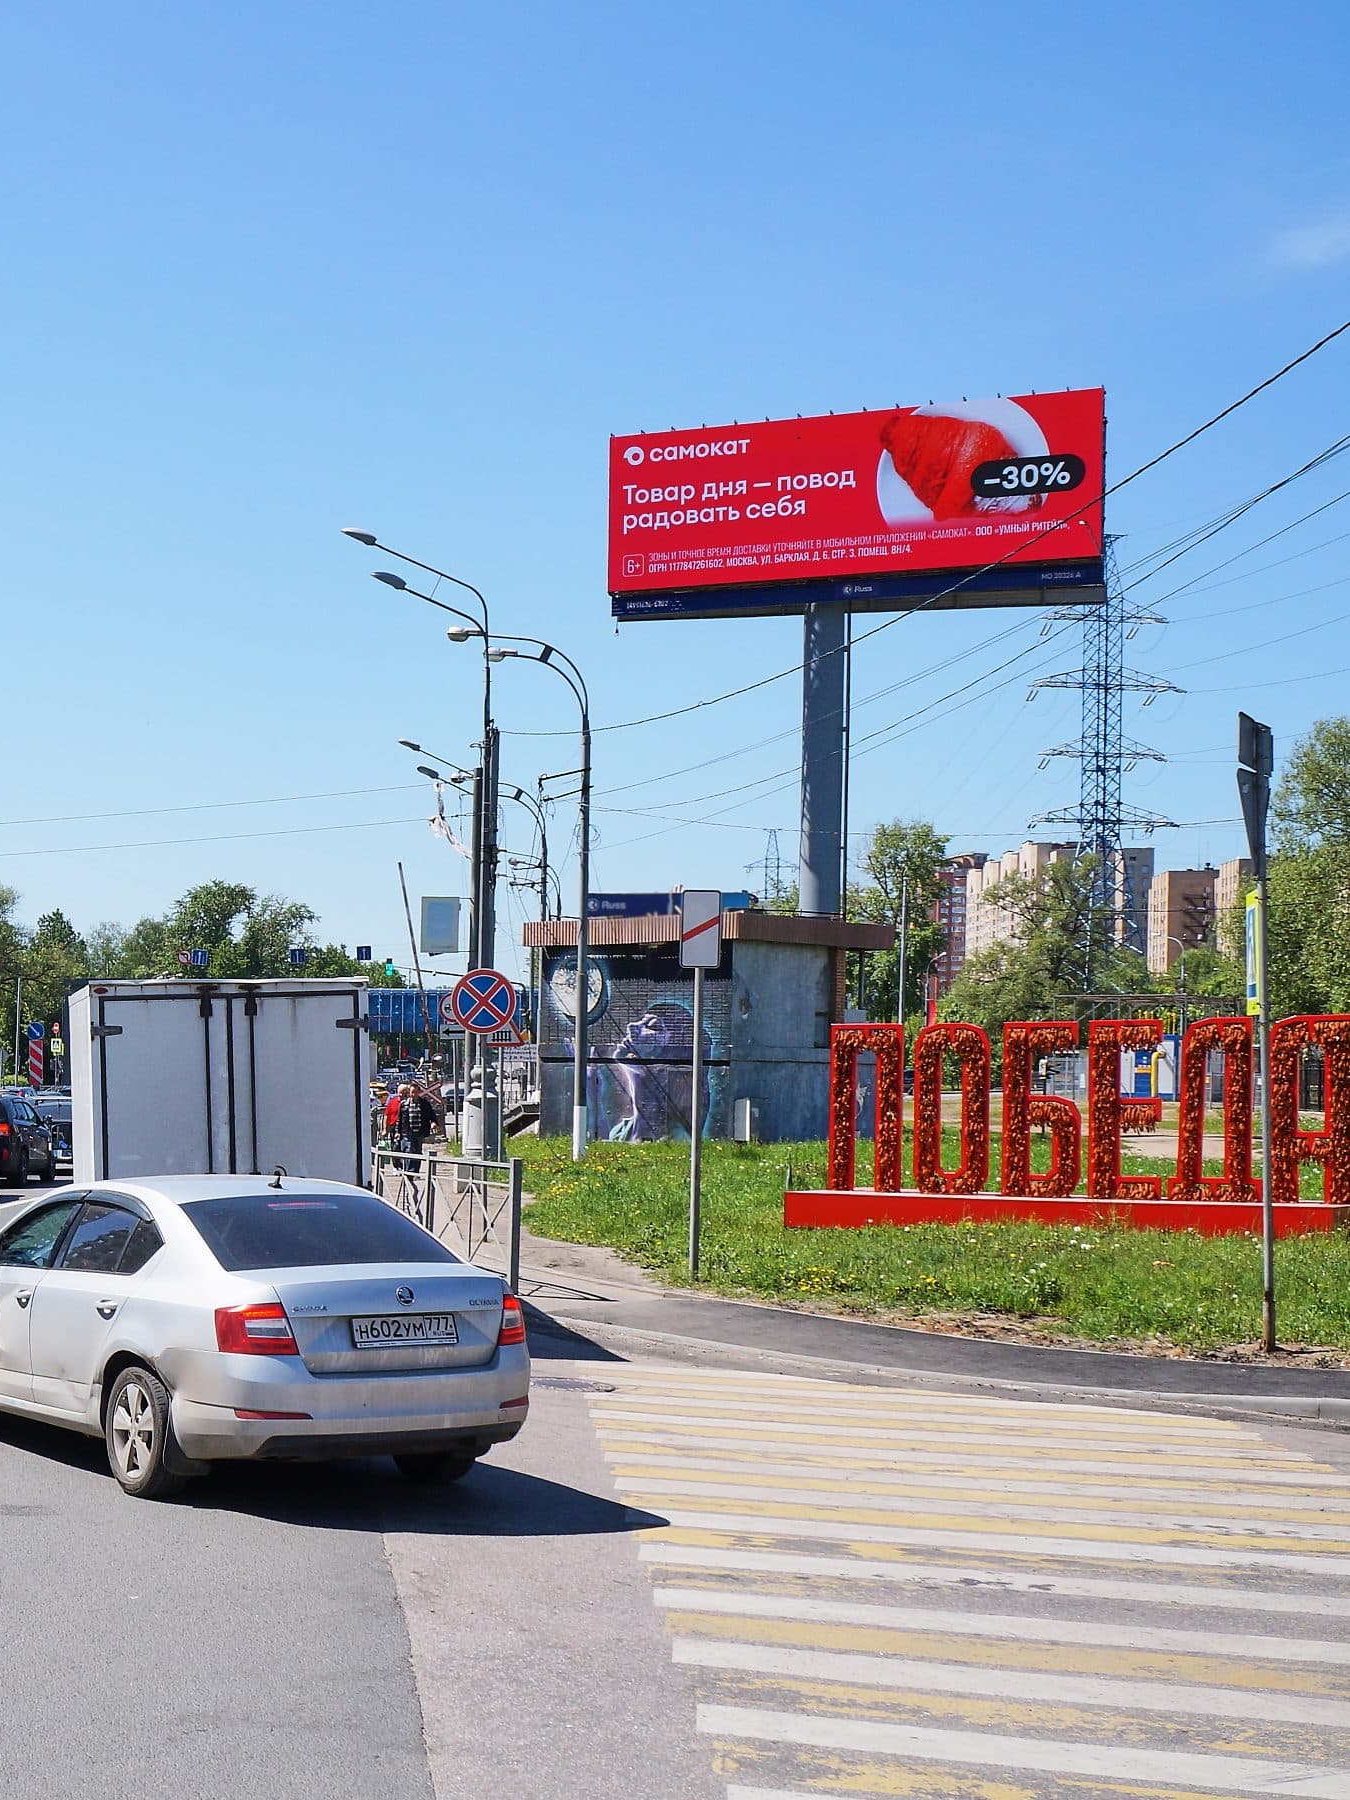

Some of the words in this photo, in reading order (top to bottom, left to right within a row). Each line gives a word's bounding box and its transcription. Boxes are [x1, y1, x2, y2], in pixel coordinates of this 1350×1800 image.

[649, 438, 751, 462] самокат
[622, 483, 696, 505] Товар
[701, 479, 747, 501] дня
[777, 469, 857, 492] повод
[983, 461, 1071, 490] -30%
[622, 506, 740, 535] радовать
[745, 494, 806, 519] себя
[648, 552, 670, 562] ЗОНЫ
[671, 552, 677, 560] И
[678, 548, 705, 560] ТОЧНОЕ
[707, 546, 731, 557] ВРЕМЯ
[733, 543, 771, 556] ДОСТАВКИ
[773, 539, 814, 553] УТОЧНЯЙТЕ
[816, 539, 822, 549] В
[823, 535, 872, 548] МОБИЛЬНОМ
[873, 531, 927, 544] ПРИЛОЖЕНИИ
[975, 525, 993, 537] ООО
[994, 521, 1030, 536] «УМНЫЙ
[627, 560, 642, 574] 6+
[648, 563, 667, 573] ОГРН
[726, 555, 760, 567] МОСКВА,
[760, 554, 773, 566] УЛ.
[812, 551, 821, 562] Д.
[831, 549, 848, 559] СТР.
[858, 546, 890, 558] ПОМЕЩ.
[601, 900, 627, 910] Russ
[827, 1014, 1350, 1205] ПОБЕДА
[359, 1319, 426, 1340] Н602УМ
[425, 1316, 449, 1331] 777
